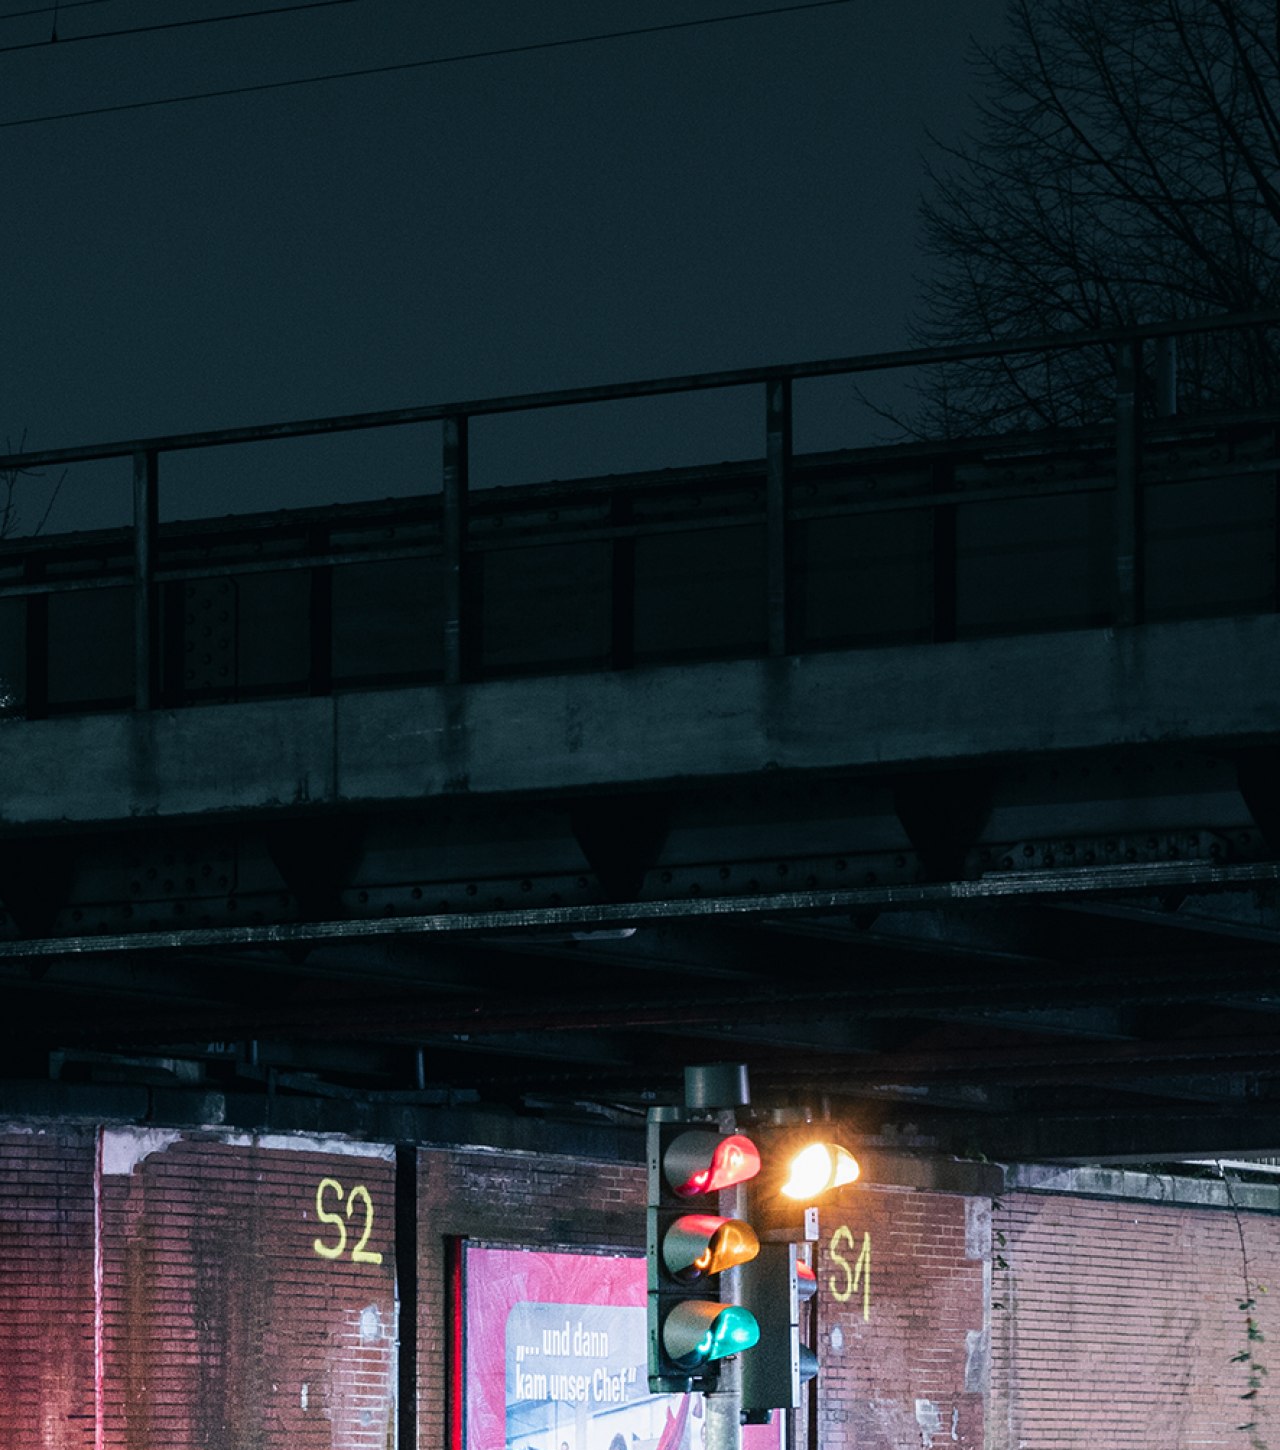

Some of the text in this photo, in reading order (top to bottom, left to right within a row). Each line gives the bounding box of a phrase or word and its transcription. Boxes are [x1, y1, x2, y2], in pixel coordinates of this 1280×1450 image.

[314, 1177, 383, 1265] S2
[829, 1225, 871, 1323] S1
[542, 1320, 570, 1356] und
[573, 1320, 609, 1357] dann
[516, 1363, 547, 1401] kam
[550, 1373, 591, 1401] unser
